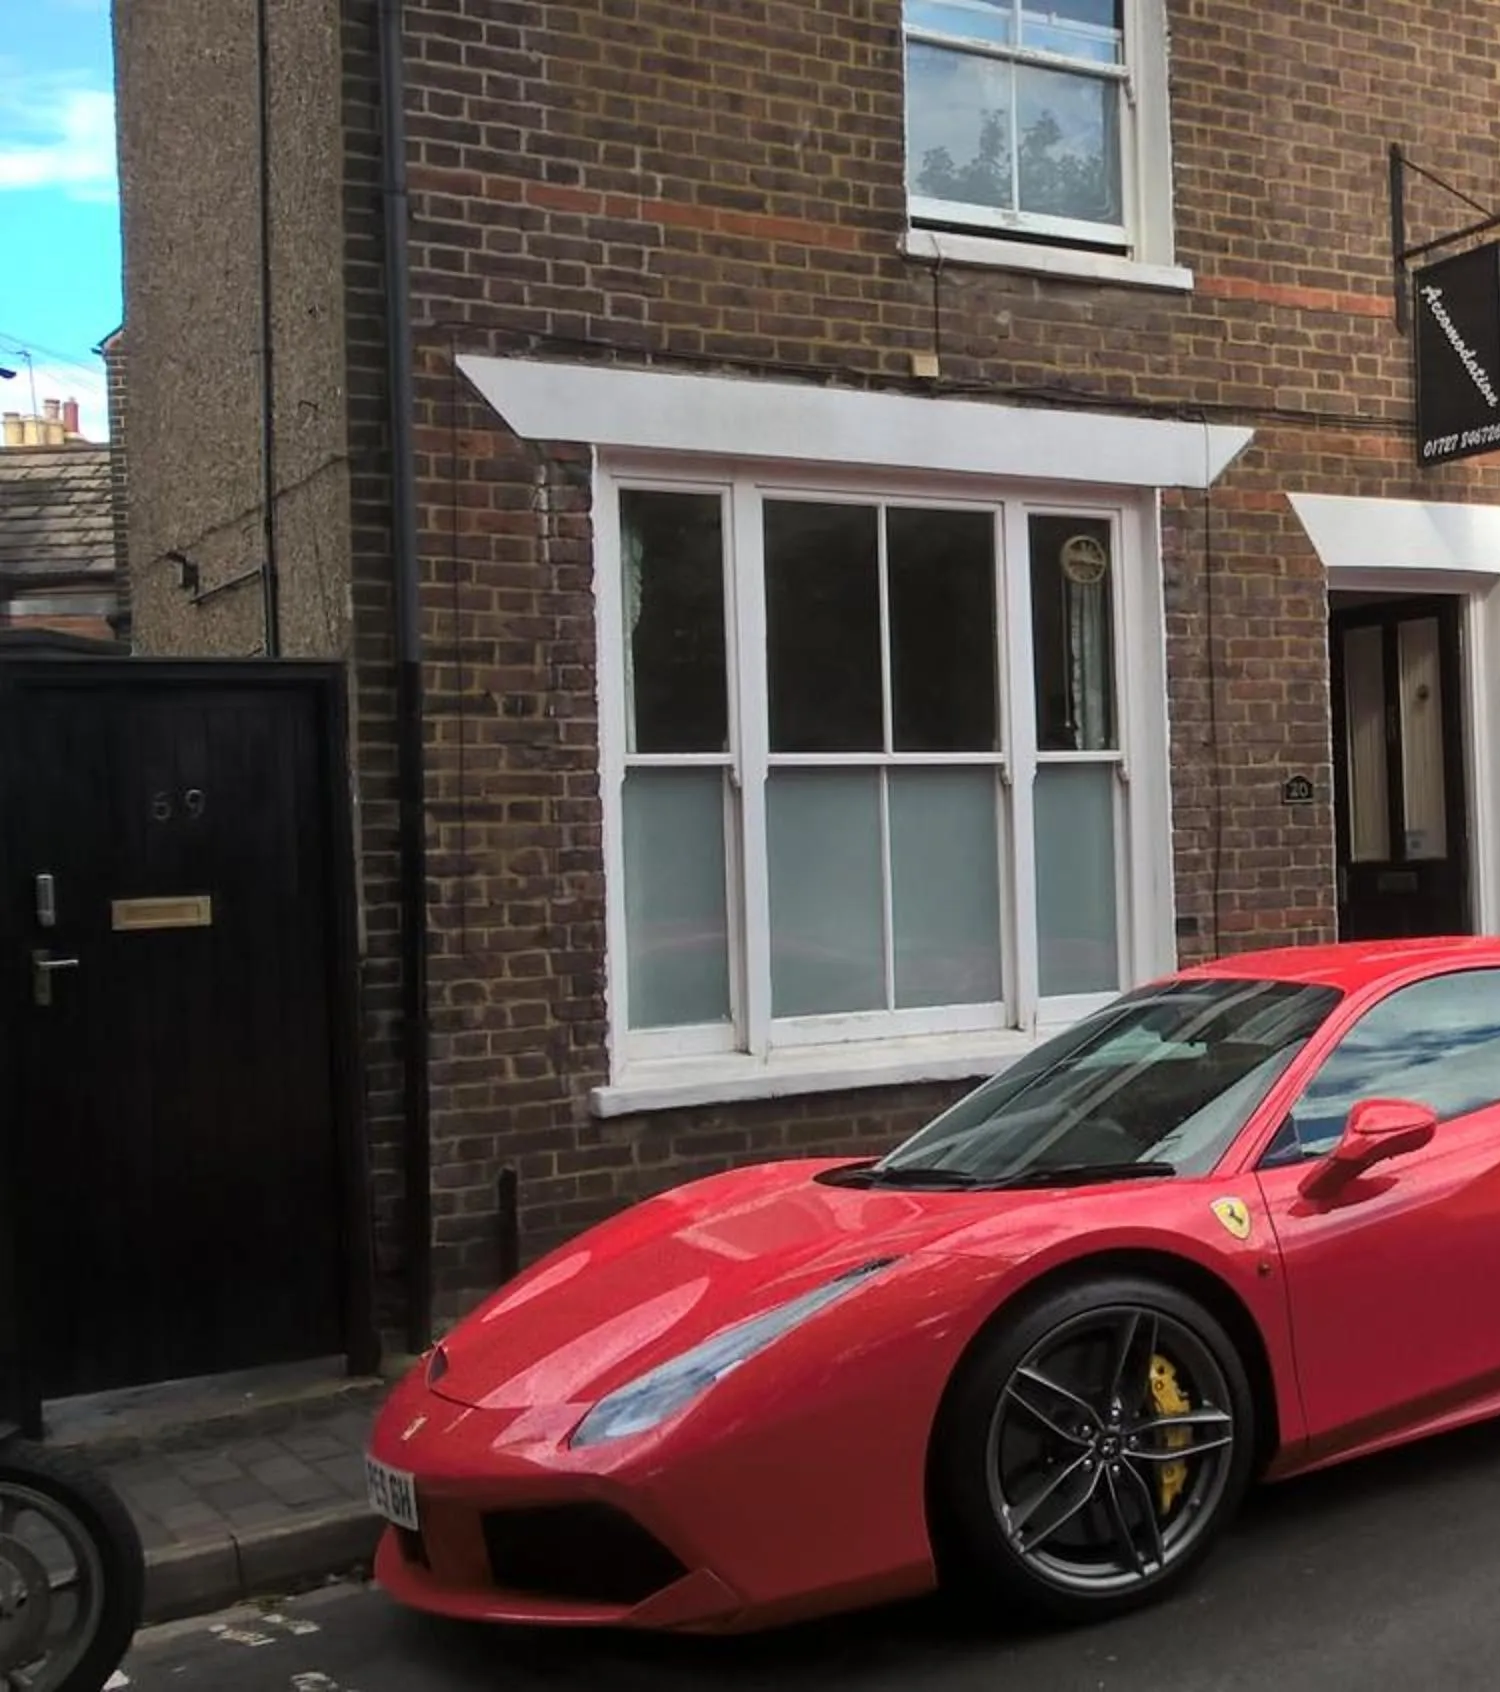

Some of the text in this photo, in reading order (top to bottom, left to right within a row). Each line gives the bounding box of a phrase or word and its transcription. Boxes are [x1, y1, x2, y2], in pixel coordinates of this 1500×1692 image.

[1420, 285, 1499, 407] Accomodation
[1423, 433, 1459, 457] 01727
[1289, 782, 1309, 797] 20
